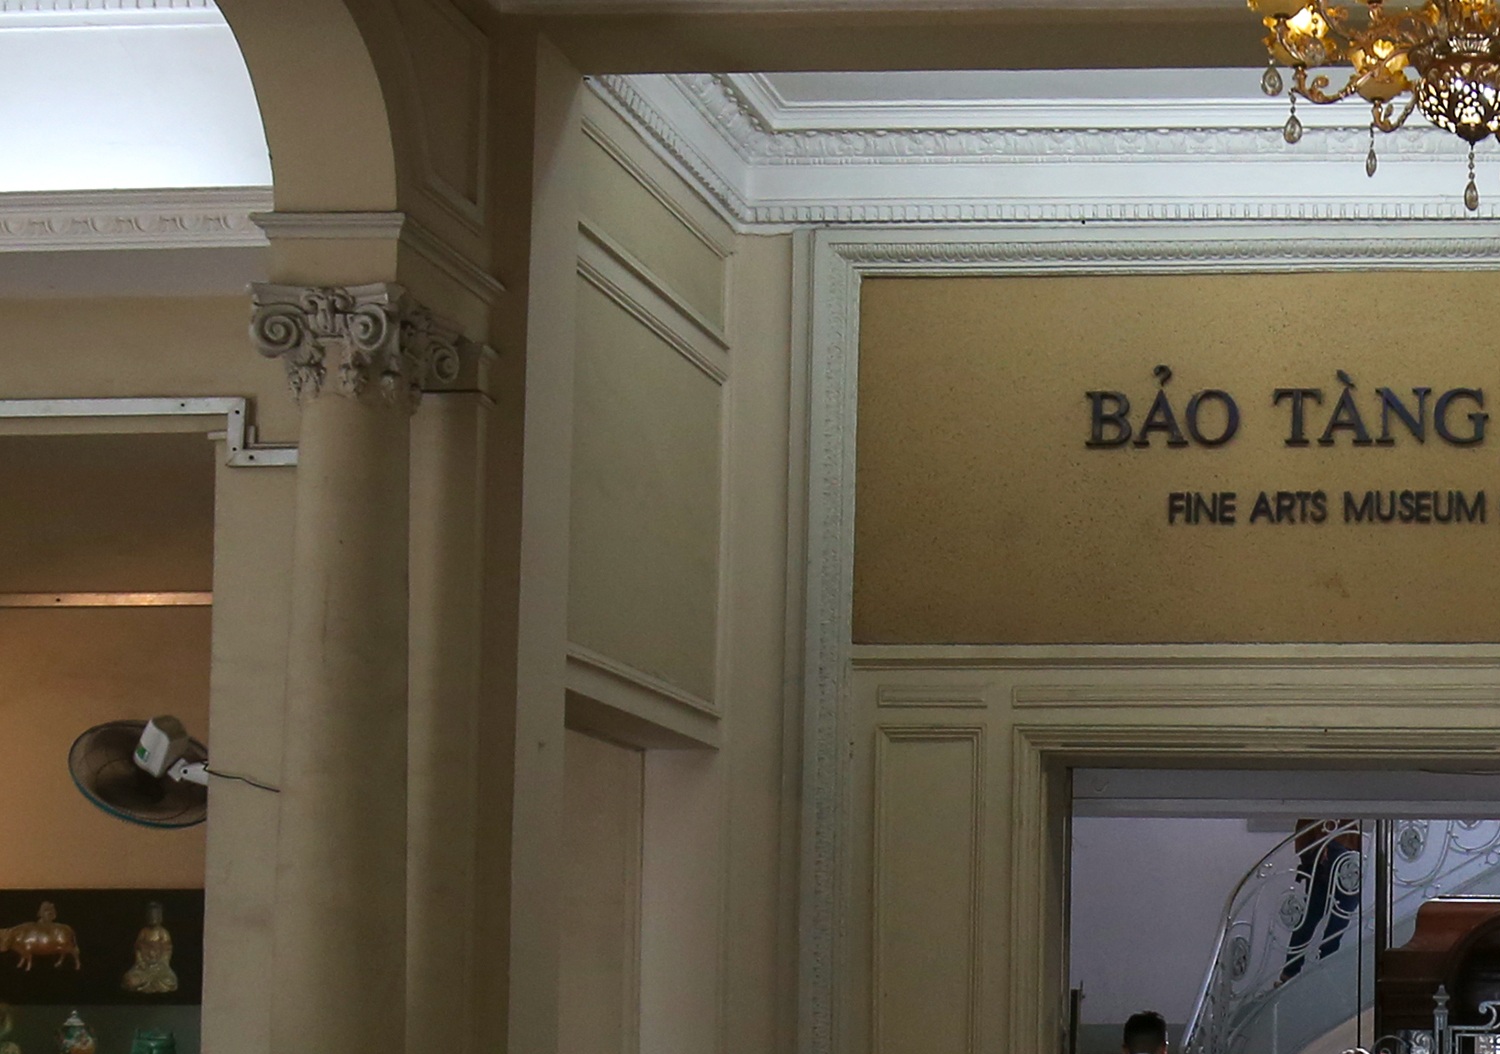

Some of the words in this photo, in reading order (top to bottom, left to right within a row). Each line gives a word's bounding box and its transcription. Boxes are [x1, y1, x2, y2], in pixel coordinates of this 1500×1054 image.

[1085, 365, 1241, 447] BẢO
[1272, 369, 1489, 446] TÀNG
[1167, 492, 1237, 524] FINE
[1248, 490, 1328, 524] ARTS
[1342, 490, 1487, 524] MUSEUM
